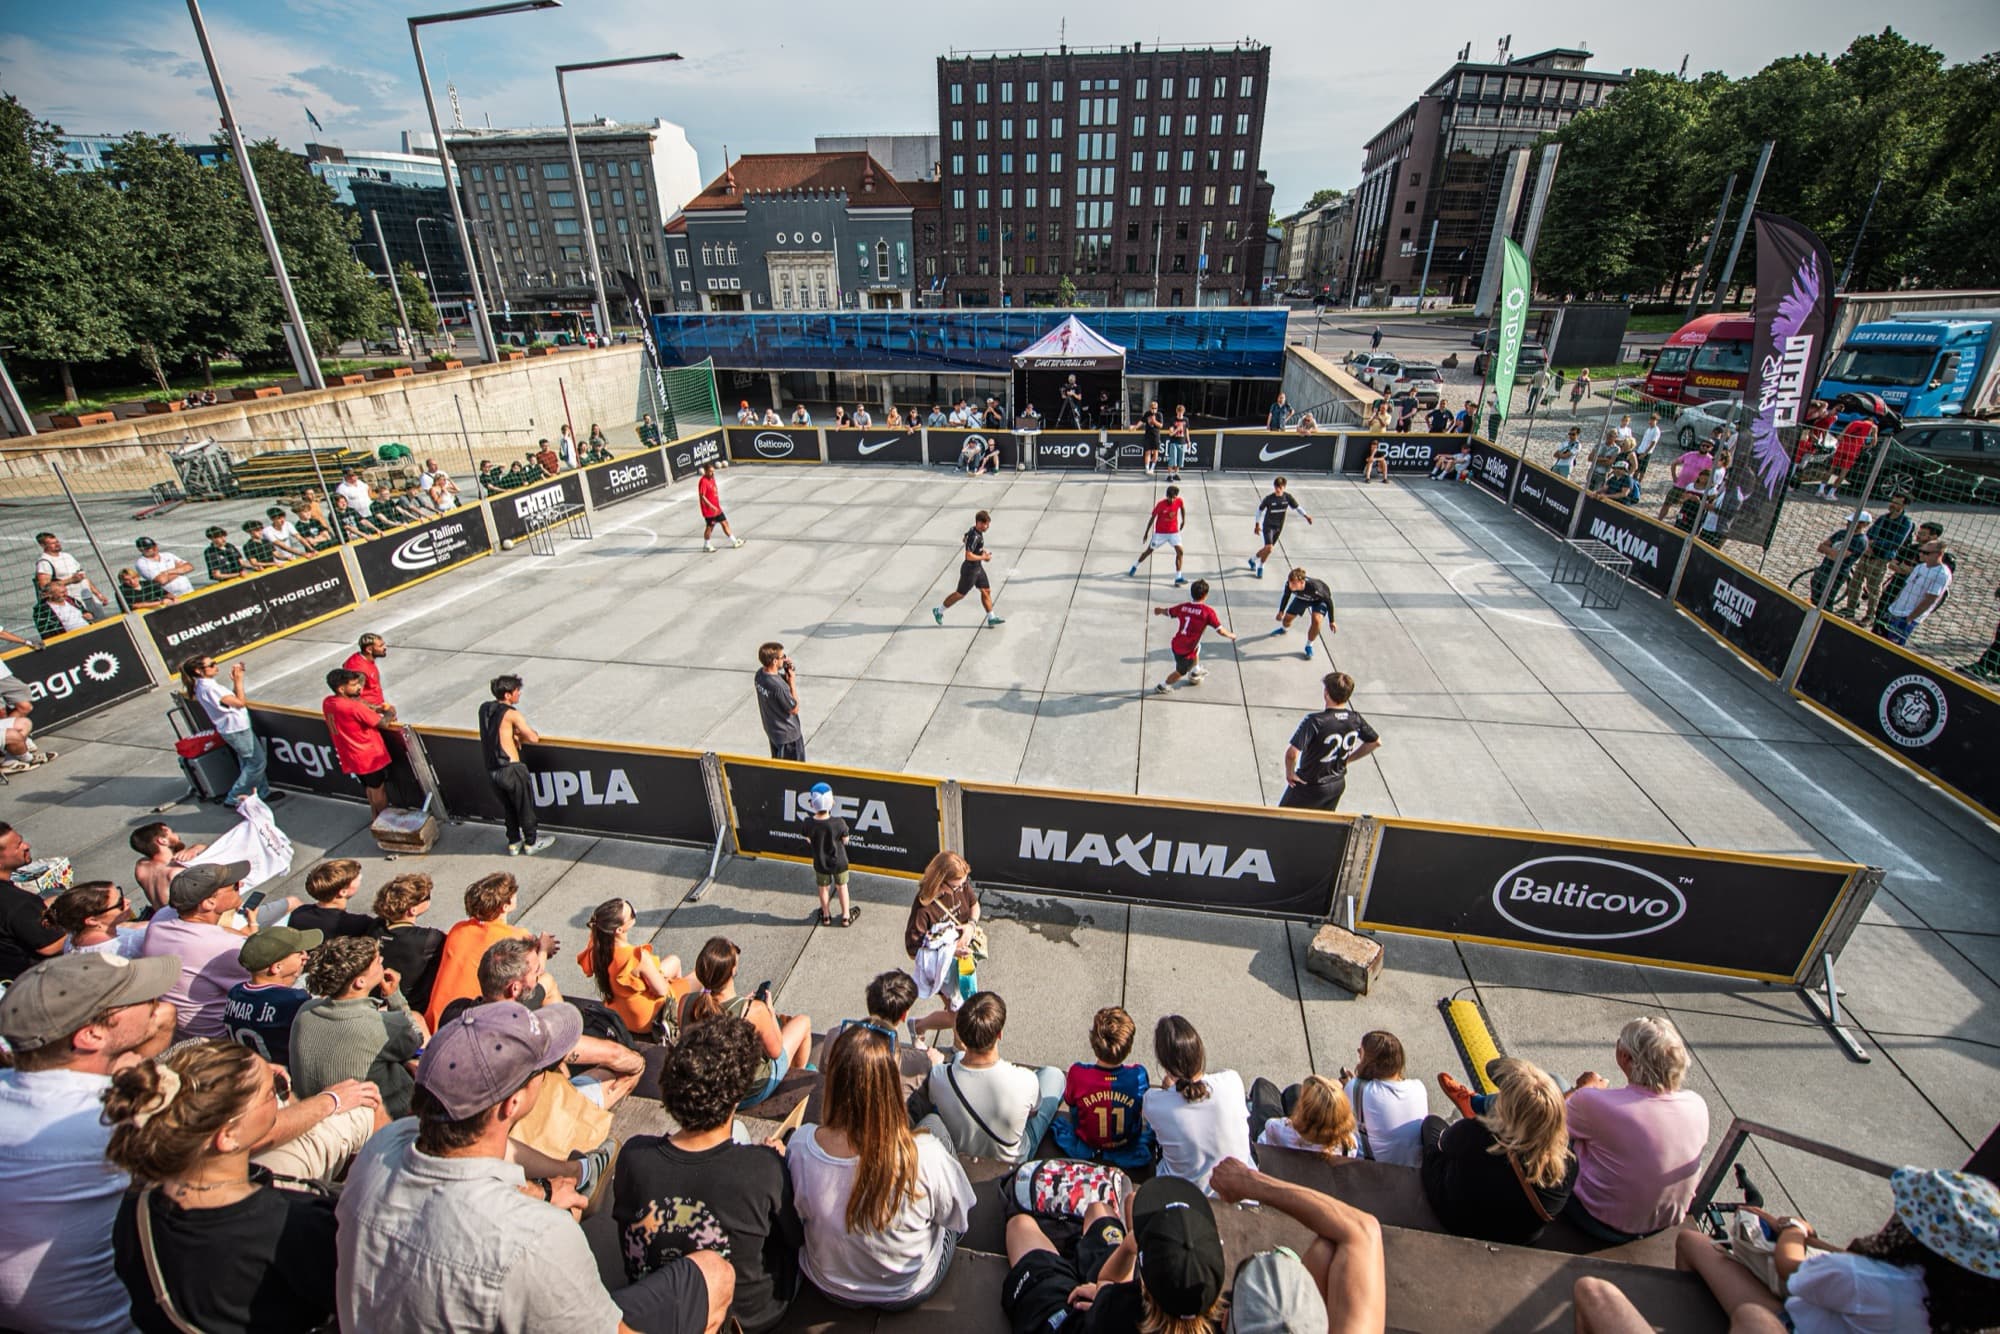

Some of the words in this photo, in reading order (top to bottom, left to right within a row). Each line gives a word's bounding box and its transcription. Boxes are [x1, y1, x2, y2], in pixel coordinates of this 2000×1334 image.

[1695, 375, 1740, 388] CORDIER
[757, 439, 791, 449] Balticovo
[1377, 442, 1431, 459] Balcia
[609, 464, 647, 487] Balcia
[1386, 459, 1430, 467] surance
[514, 484, 566, 519] GHETTO
[429, 523, 464, 541] Tallinn
[1590, 517, 1659, 568] MAXIMA
[1713, 577, 1758, 619] GHETTO
[179, 619, 216, 642] BANK
[221, 603, 263, 626] LAMPS
[1319, 730, 1359, 763] 29
[530, 769, 640, 808] UPLA
[1018, 826, 1276, 883] MAXIMA
[1510, 876, 1670, 917] Balticovo
[1082, 1089, 1135, 1108] RAPHINHA
[1093, 1106, 1125, 1138] 11
